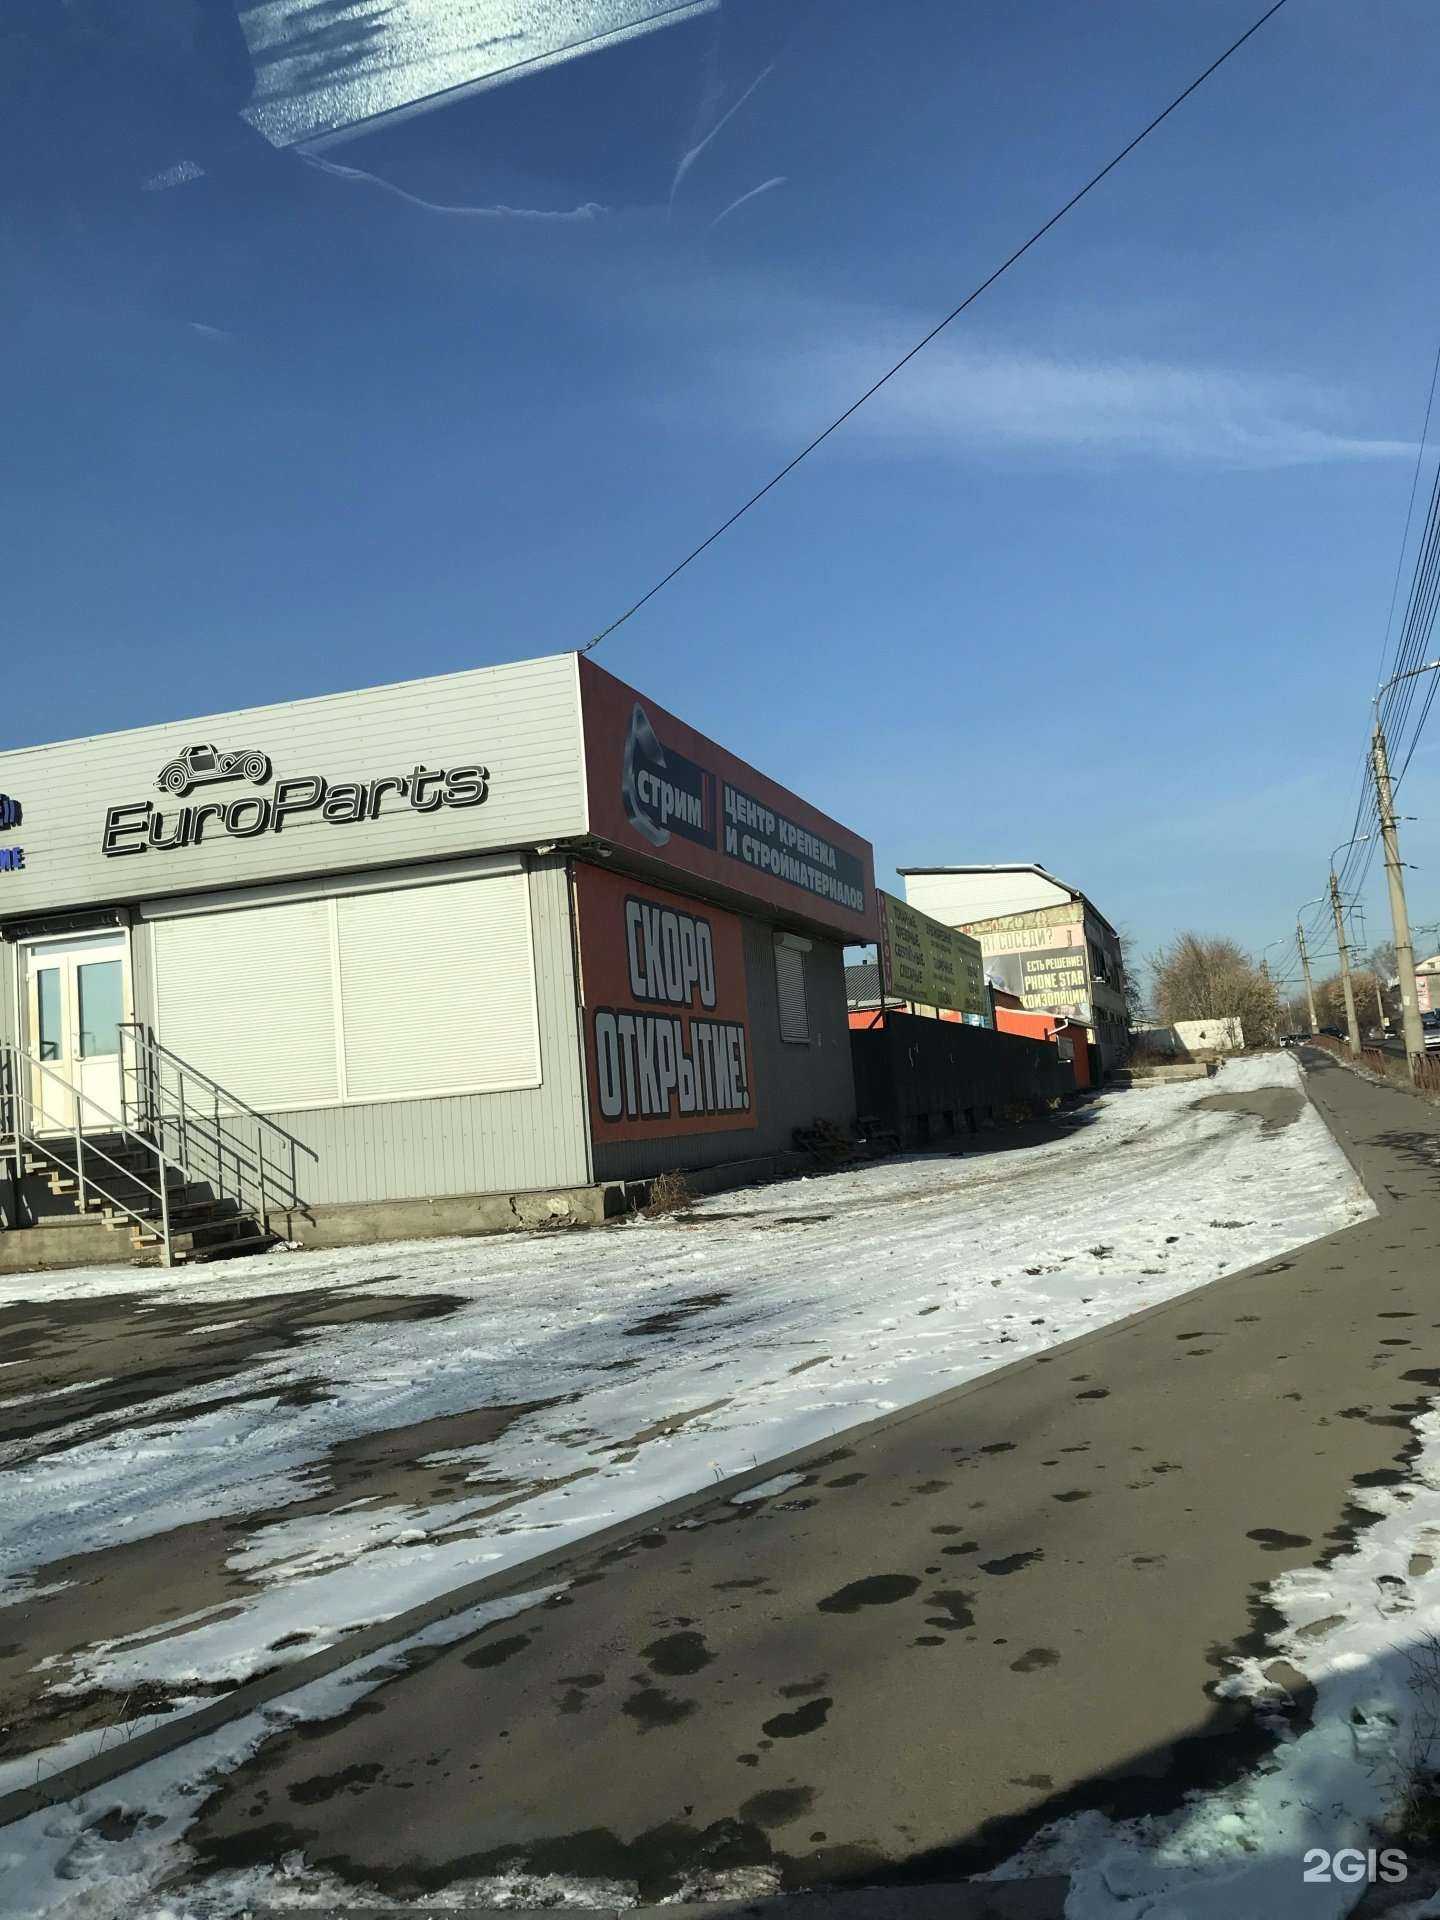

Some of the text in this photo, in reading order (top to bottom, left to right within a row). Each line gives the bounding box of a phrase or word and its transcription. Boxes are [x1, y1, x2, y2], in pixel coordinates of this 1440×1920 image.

[101, 765, 490, 857] EuroParts
[725, 786, 837, 870] ЦЕНТР КРЕПЕЖА
[726, 825, 864, 911] И СТРОЙМАТЕРИАЛОВ
[625, 900, 717, 1007] СКОРО
[1000, 929, 1053, 950] СОСЕДИ?
[1024, 970, 1084, 991] PHONE STAR
[1026, 960, 1045, 972] ЕСТЬ
[595, 1012, 749, 1117] ОТКРЫТИЕ!
